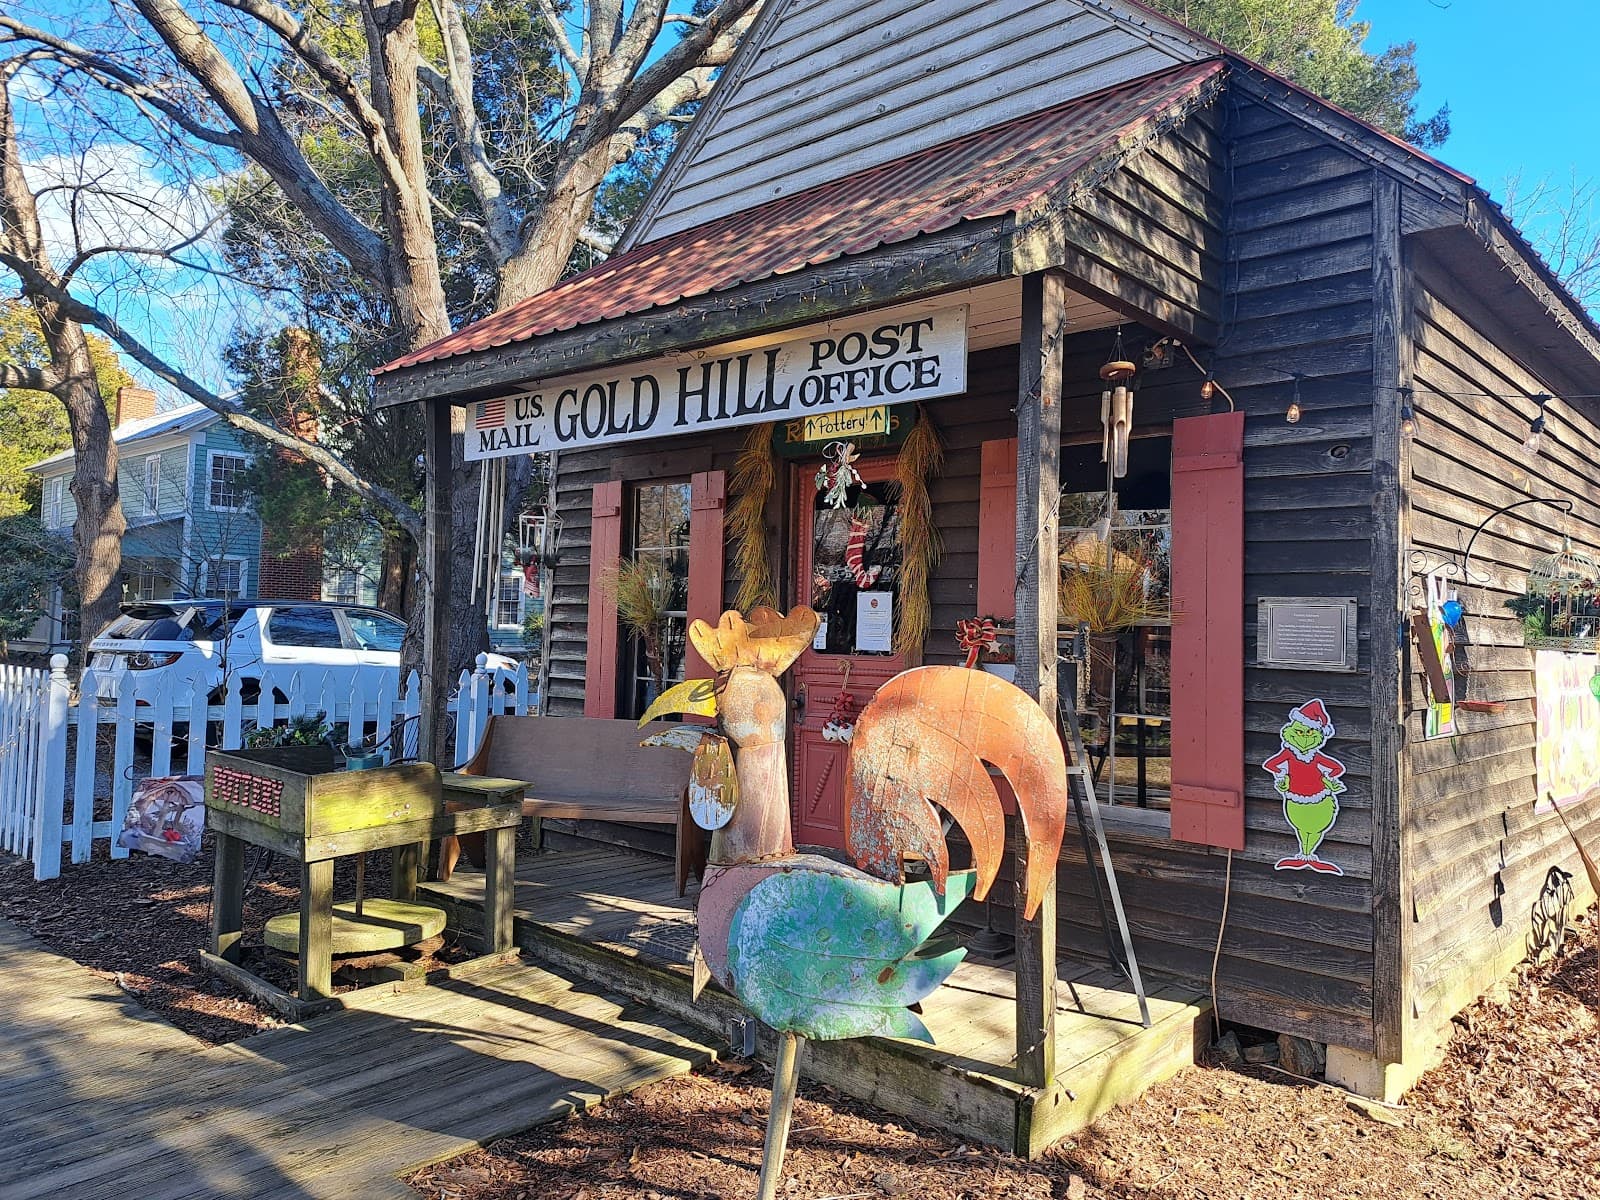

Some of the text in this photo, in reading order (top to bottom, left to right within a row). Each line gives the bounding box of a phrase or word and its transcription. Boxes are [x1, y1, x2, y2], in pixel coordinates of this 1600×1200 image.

[807, 317, 933, 372] POST
[515, 395, 545, 421] U.S.
[553, 347, 794, 443] GOLD HILL
[798, 355, 941, 408] OFFICE
[478, 423, 541, 453] MAIL
